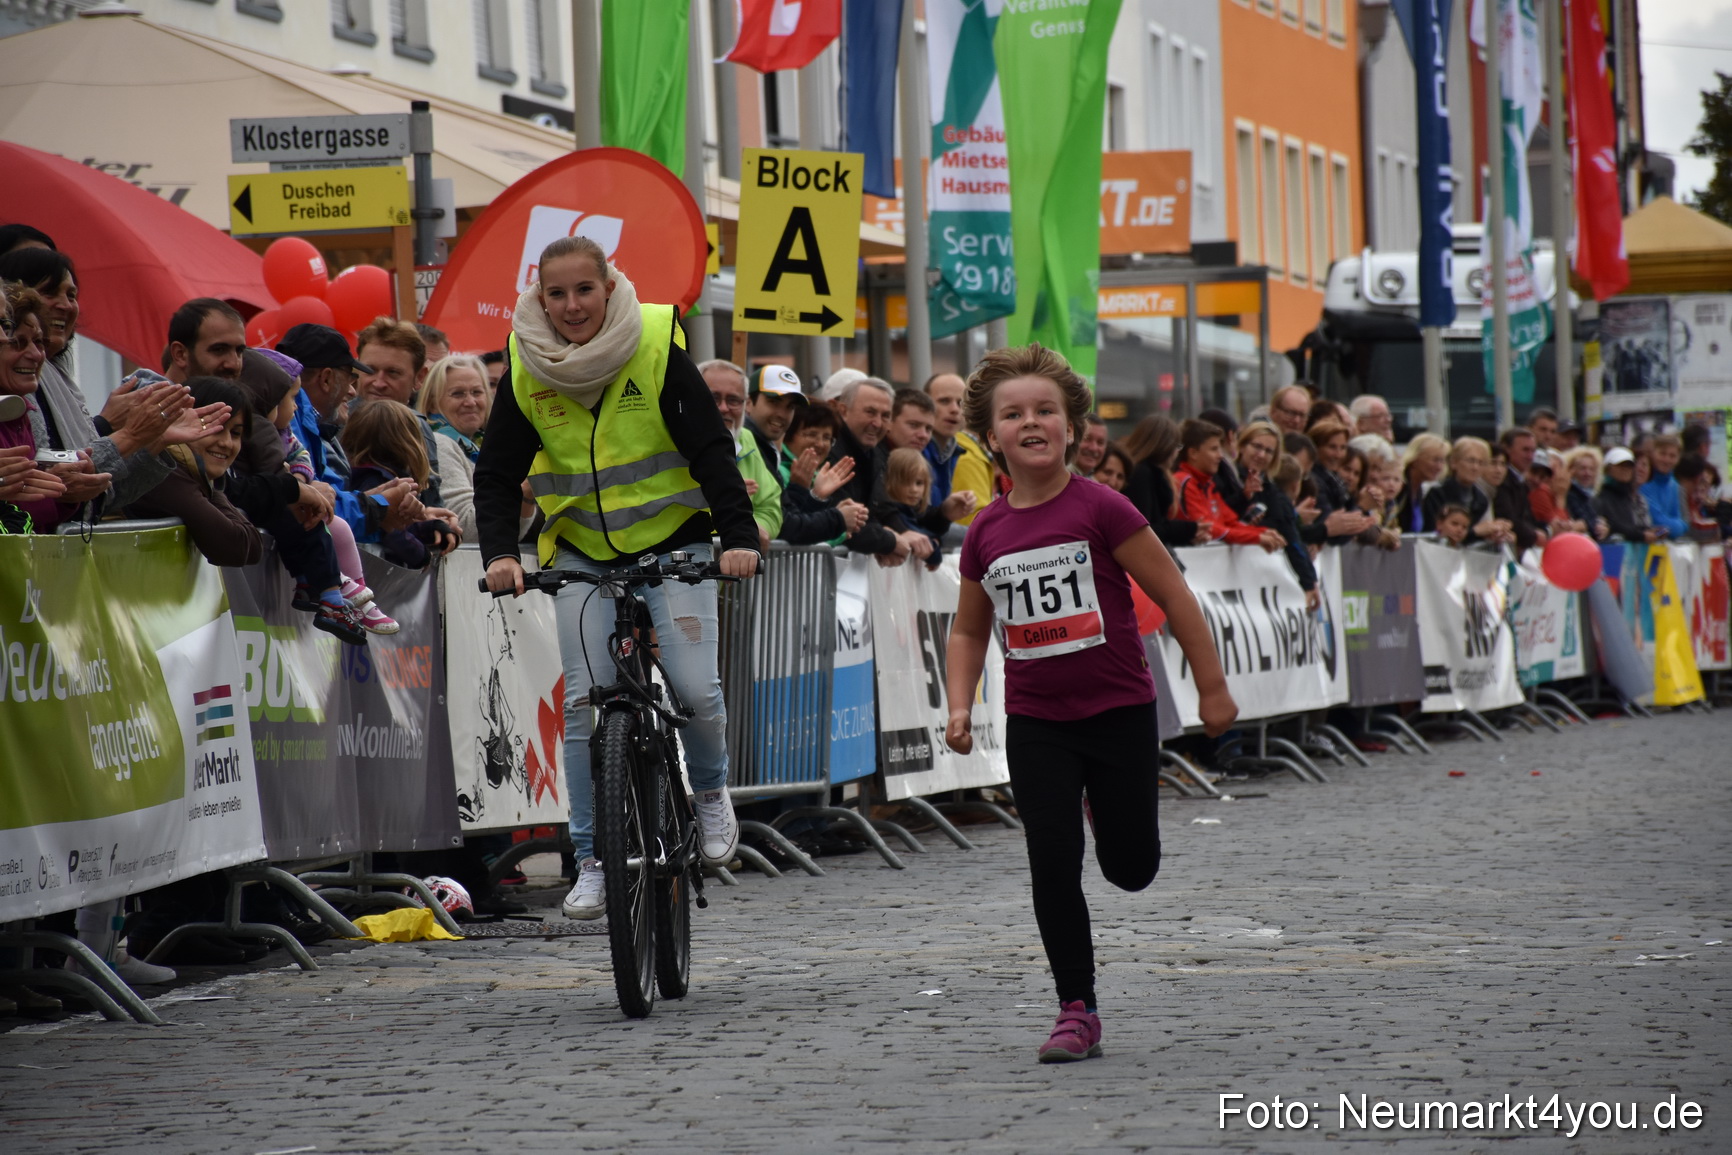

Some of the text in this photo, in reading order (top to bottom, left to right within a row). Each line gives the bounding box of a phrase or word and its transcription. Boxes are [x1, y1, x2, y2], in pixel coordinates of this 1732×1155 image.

[243, 125, 389, 155] Klostergasse
[757, 155, 851, 193] Block
[282, 182, 355, 200] Duschen
[289, 202, 351, 219] Freibad
[760, 206, 831, 296] A
[477, 302, 500, 317] Wir
[984, 556, 1070, 580] ARTL Neumarkt
[995, 570, 1082, 620] 7151
[1023, 626, 1068, 645] Celina
[86, 701, 160, 781] langgeht!
[270, 731, 282, 768] by
